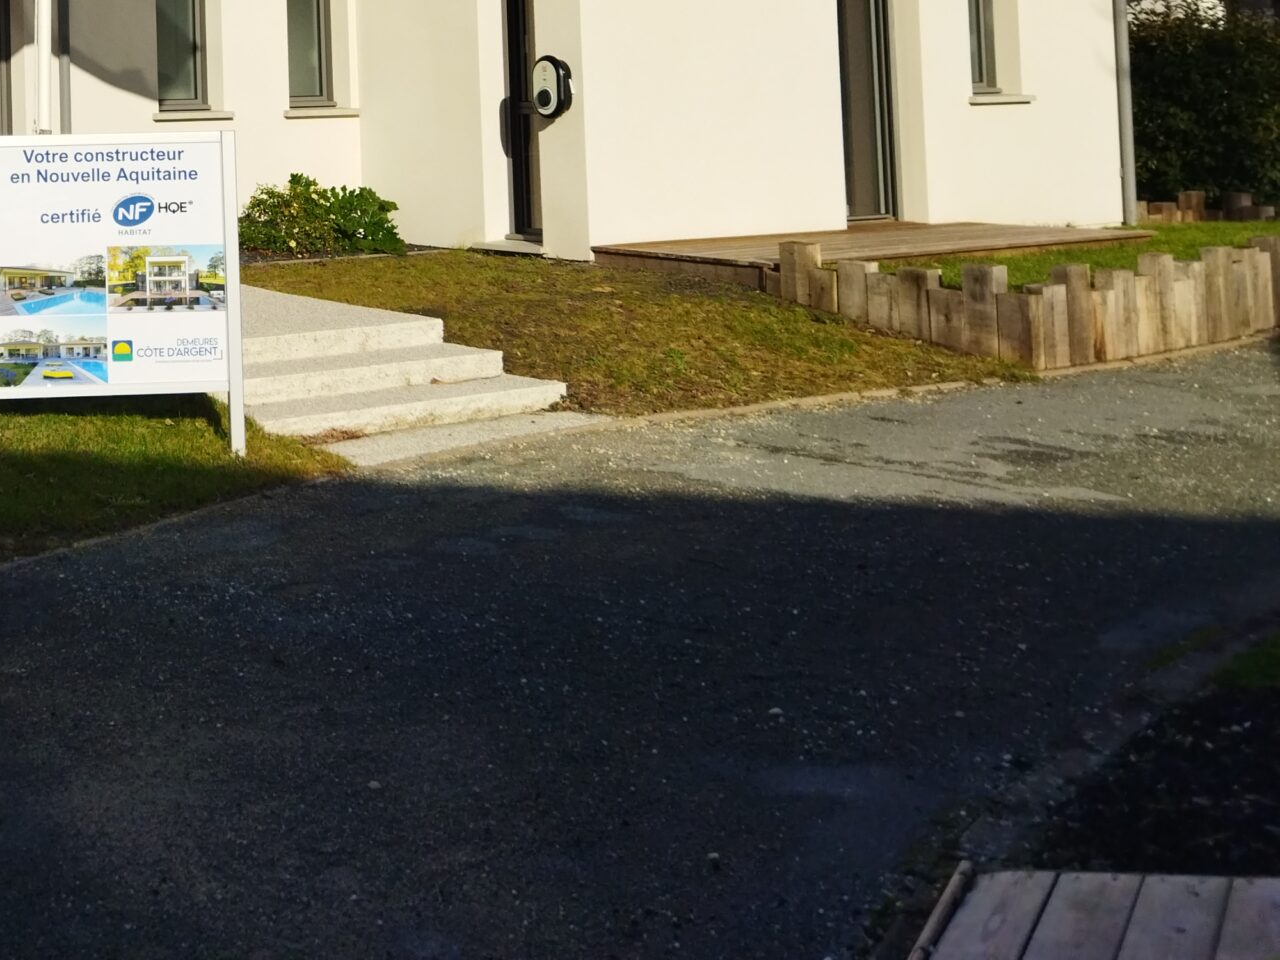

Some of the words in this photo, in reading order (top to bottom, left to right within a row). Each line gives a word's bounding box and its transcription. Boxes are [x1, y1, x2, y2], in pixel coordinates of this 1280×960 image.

[23, 149, 69, 164] Votre
[73, 147, 184, 162] constructeur
[10, 172, 31, 183] en
[36, 168, 111, 183] Nouvelle
[116, 166, 199, 184] Aquitaine
[40, 208, 102, 224] certifié
[117, 201, 152, 221] NF
[176, 338, 218, 347] DEMEURES
[137, 346, 165, 358] CÔTE
[167, 346, 218, 357] D'ARGENT
